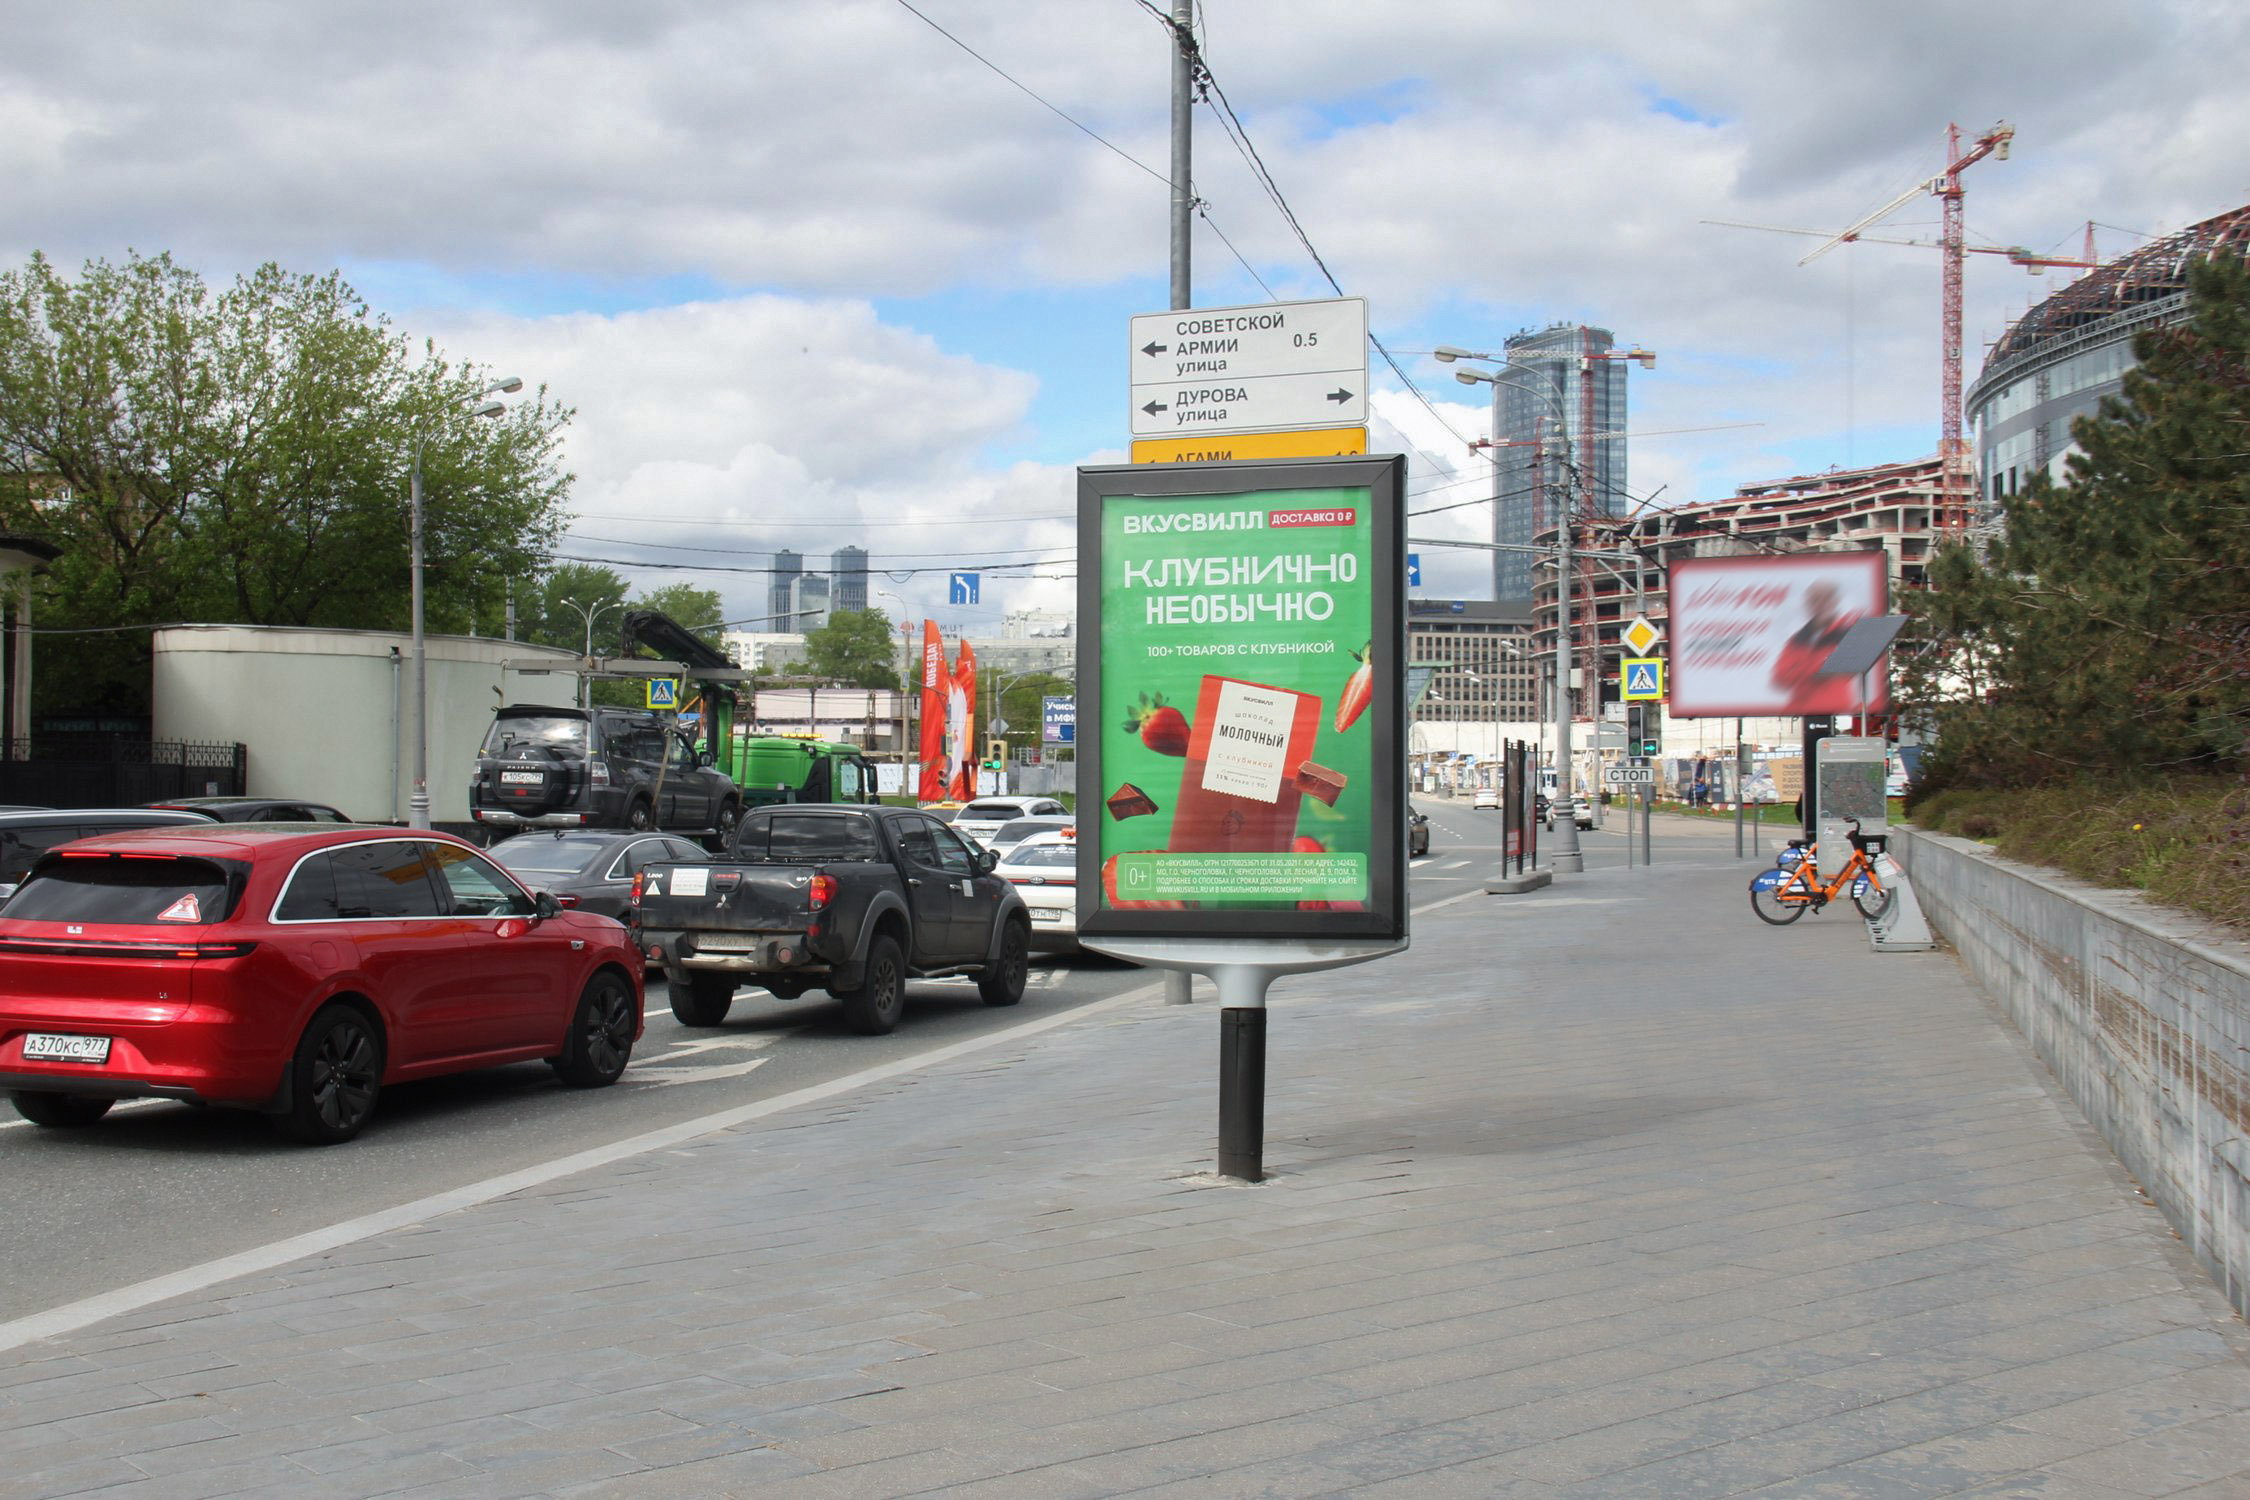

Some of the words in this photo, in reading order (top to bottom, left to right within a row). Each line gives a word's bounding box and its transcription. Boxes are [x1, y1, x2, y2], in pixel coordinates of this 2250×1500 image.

[1176, 311, 1284, 335] СОВЕТСКОЙ
[1176, 338, 1238, 356] АРМИИ
[1293, 332, 1318, 347] 0.5
[1176, 360, 1227, 376] улица
[1176, 387, 1248, 408] ДУРОВА
[1176, 409, 1227, 425] улица
[1123, 511, 1263, 534] ВКУСВИЛЛ
[1123, 553, 1357, 588] КЛУБНИЧНО
[1146, 591, 1334, 624] НЕОБЫЧНО
[1147, 646, 1173, 657] 100+
[1175, 644, 1235, 656] ТОВАРОВ
[1237, 643, 1248, 655] С
[1250, 639, 1334, 655] КЛУБНИКОЙ
[926, 643, 938, 688] ПОБЕДА!
[1219, 724, 1284, 748] МОЛОЧНЫЙ
[1610, 770, 1649, 781] СТОП
[1129, 867, 1148, 885] 0+
[84, 1039, 105, 1052] 977
